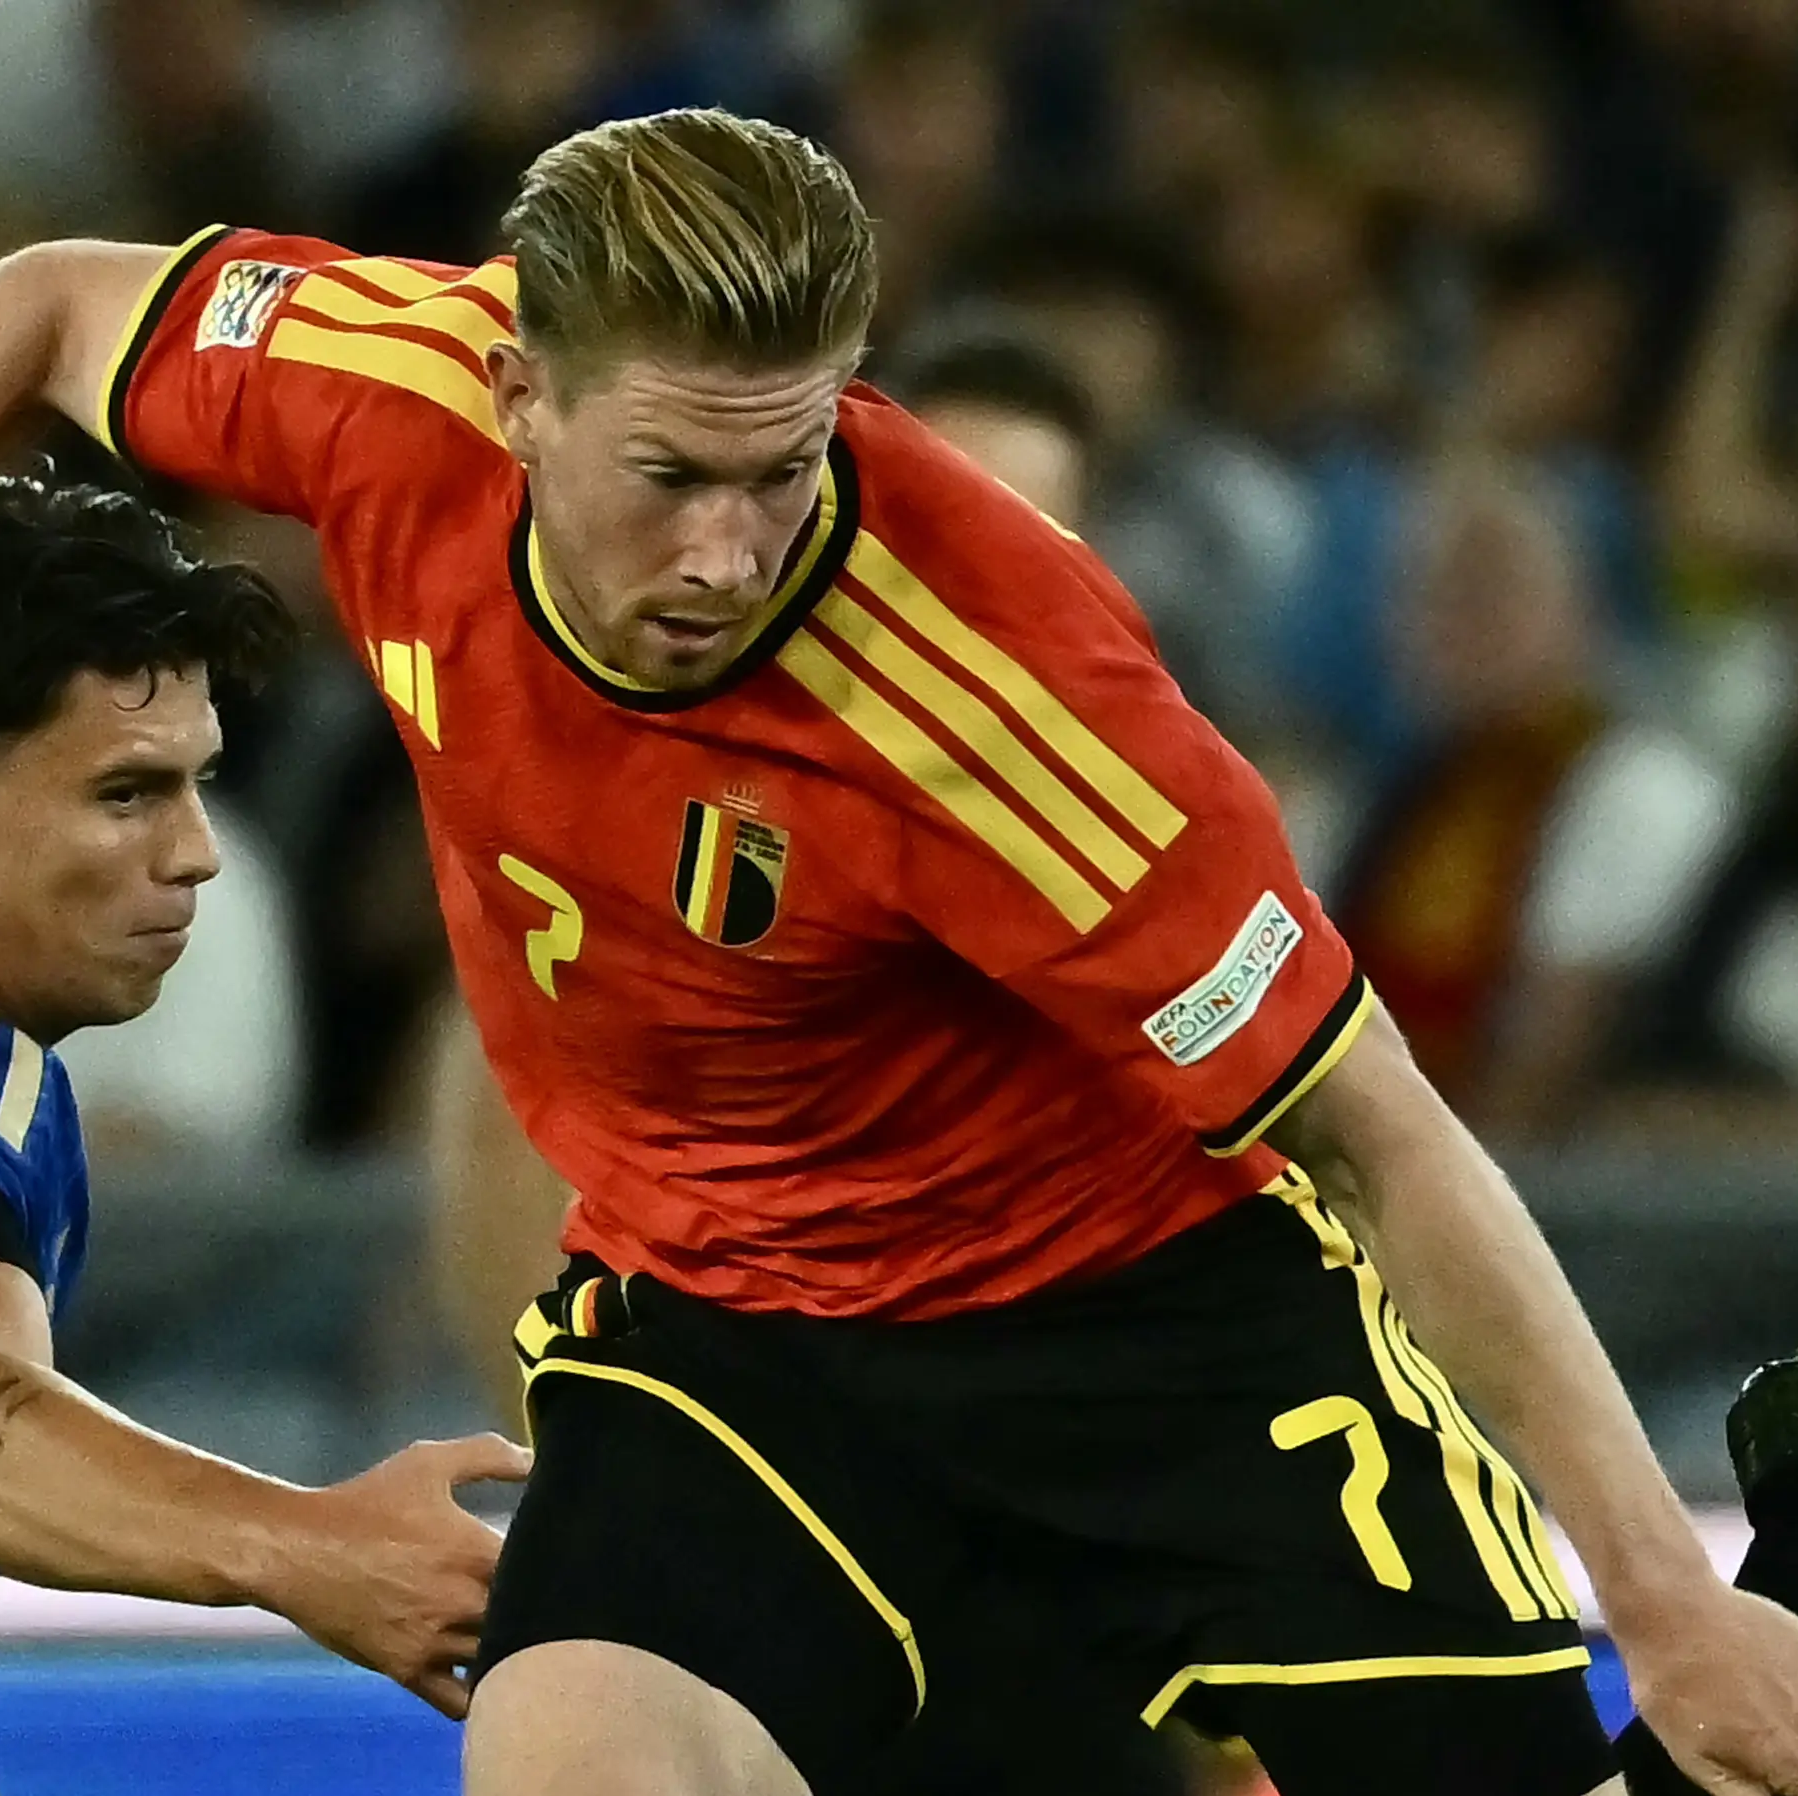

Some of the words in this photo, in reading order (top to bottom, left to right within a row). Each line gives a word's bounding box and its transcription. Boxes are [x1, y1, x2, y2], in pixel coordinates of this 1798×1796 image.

[498, 853, 584, 1002] 7
[1160, 909, 1287, 1051] FOUNDATION
[1151, 1002, 1187, 1034] UEFA
[1269, 1395, 1412, 1592] 7
